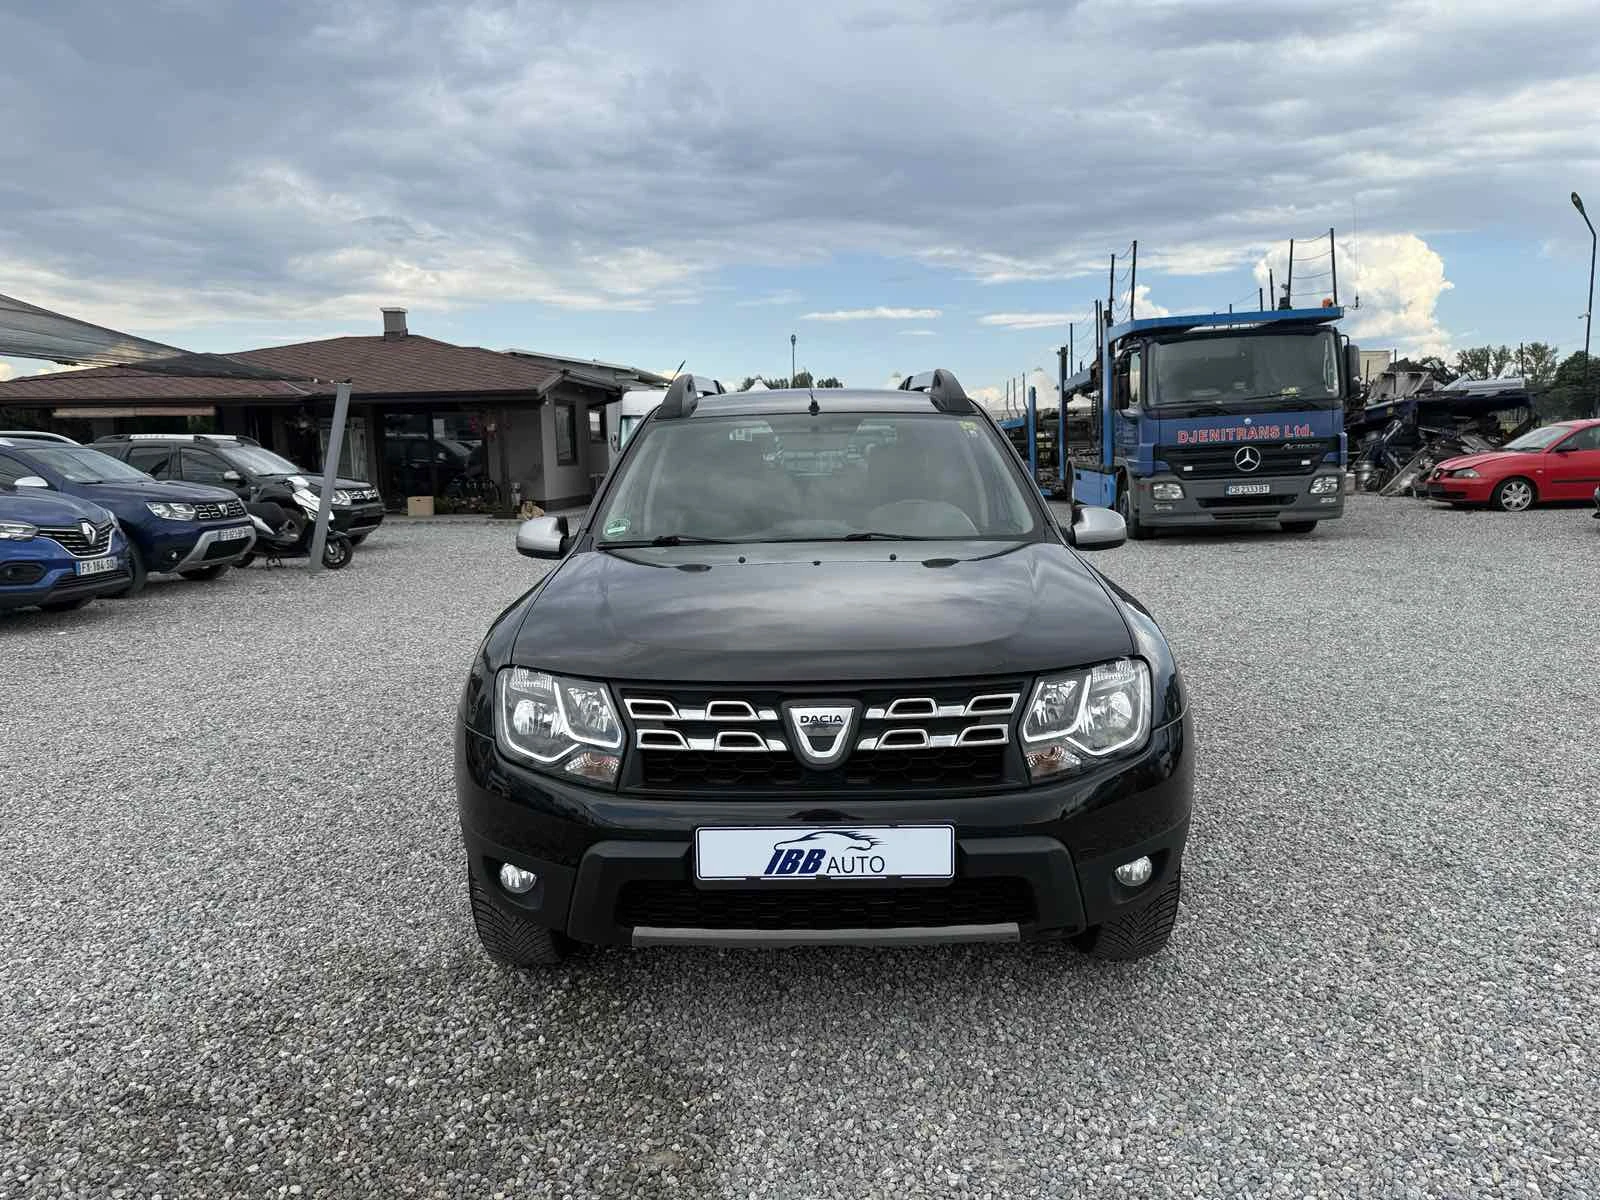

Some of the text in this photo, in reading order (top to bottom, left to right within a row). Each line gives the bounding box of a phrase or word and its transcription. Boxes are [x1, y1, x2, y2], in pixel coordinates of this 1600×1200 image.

[1177, 424, 1314, 443] DJENITRANS Ltd.
[800, 714, 844, 724] DACIA
[763, 849, 885, 874] IBB AUTO
